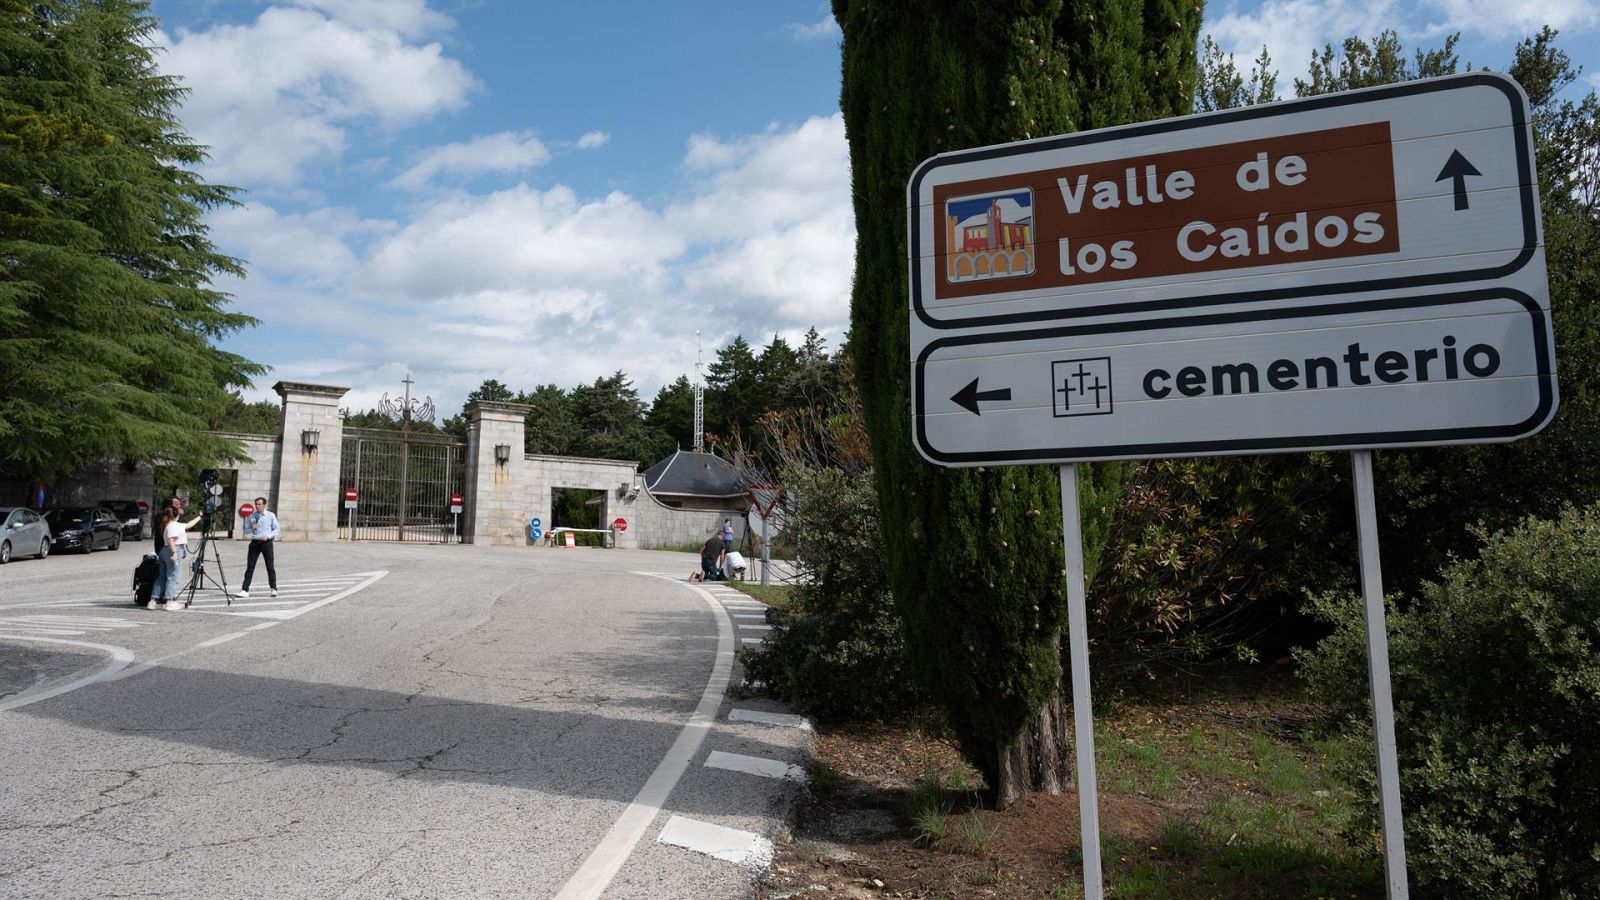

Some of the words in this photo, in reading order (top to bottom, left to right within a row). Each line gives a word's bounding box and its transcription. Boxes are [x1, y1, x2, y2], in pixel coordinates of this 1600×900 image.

[1056, 164, 1195, 214] Valle
[1236, 151, 1307, 192] de
[1058, 237, 1138, 276] los
[1176, 211, 1385, 262] Caídos
[1143, 334, 1501, 401] cementerio
